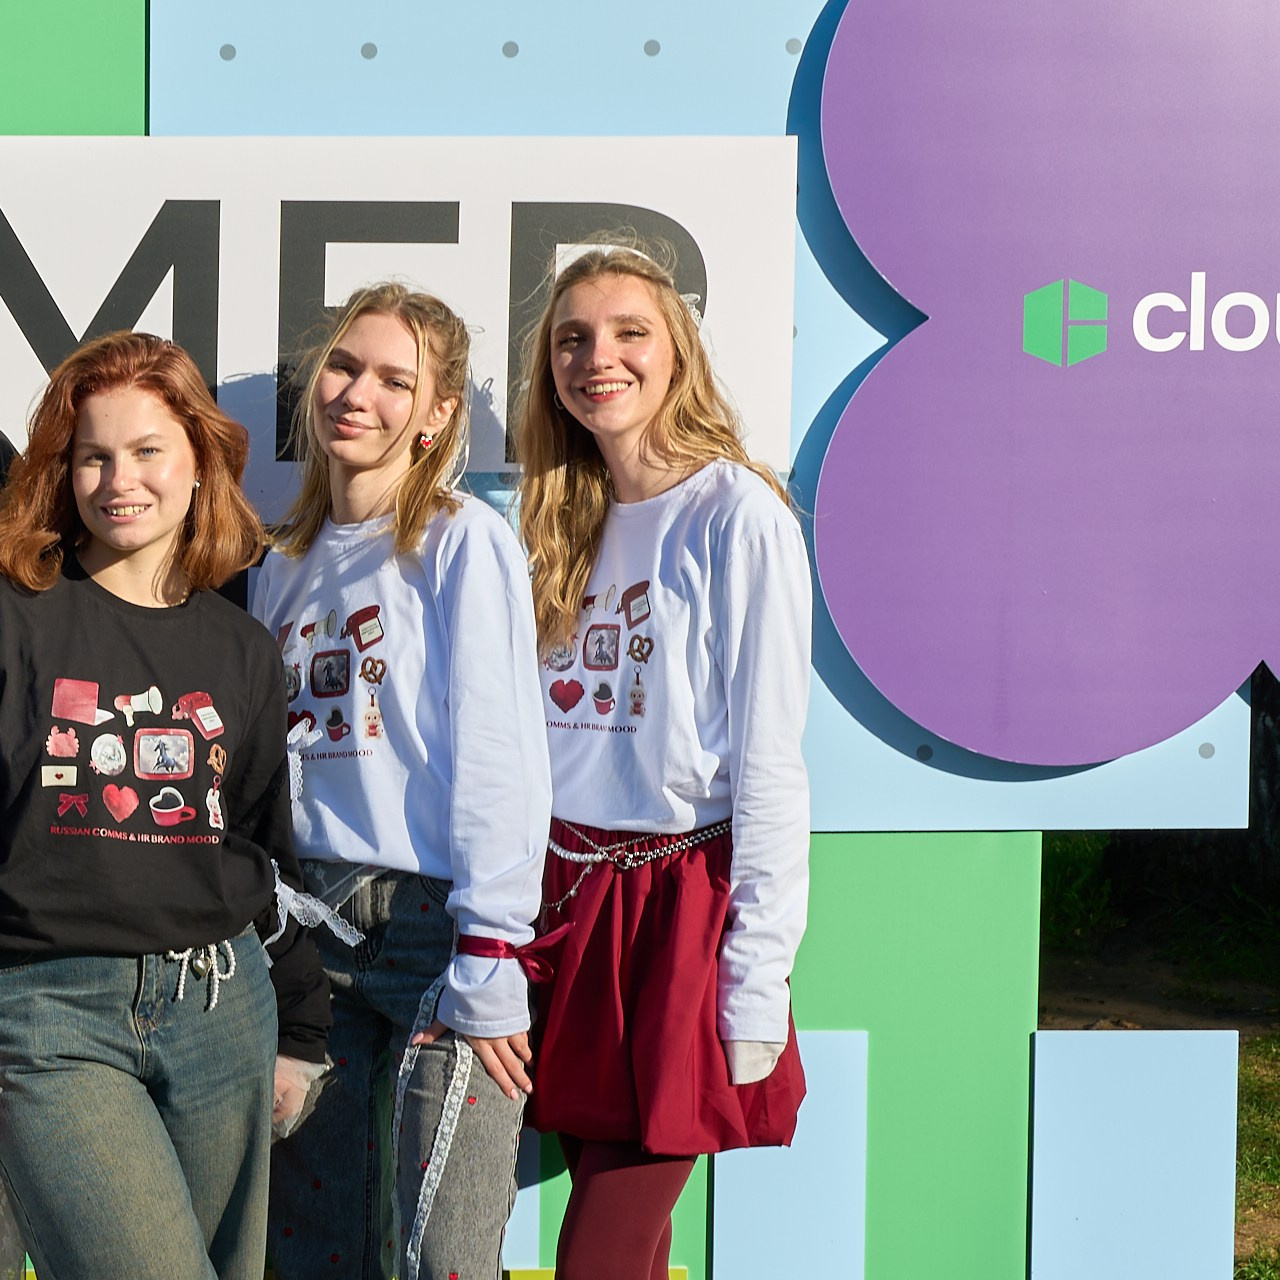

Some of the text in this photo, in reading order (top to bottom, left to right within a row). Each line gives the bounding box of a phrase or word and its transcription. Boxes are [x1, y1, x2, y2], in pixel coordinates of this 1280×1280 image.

[1132, 271, 1280, 352] clo
[546, 720, 571, 730] OMMS
[572, 722, 579, 730] &
[580, 722, 591, 730] HR
[608, 725, 637, 733] MOOD
[316, 752, 327, 760] HR
[50, 825, 220, 844] RUSSIAN COMMS & HR BRAND MOOD
